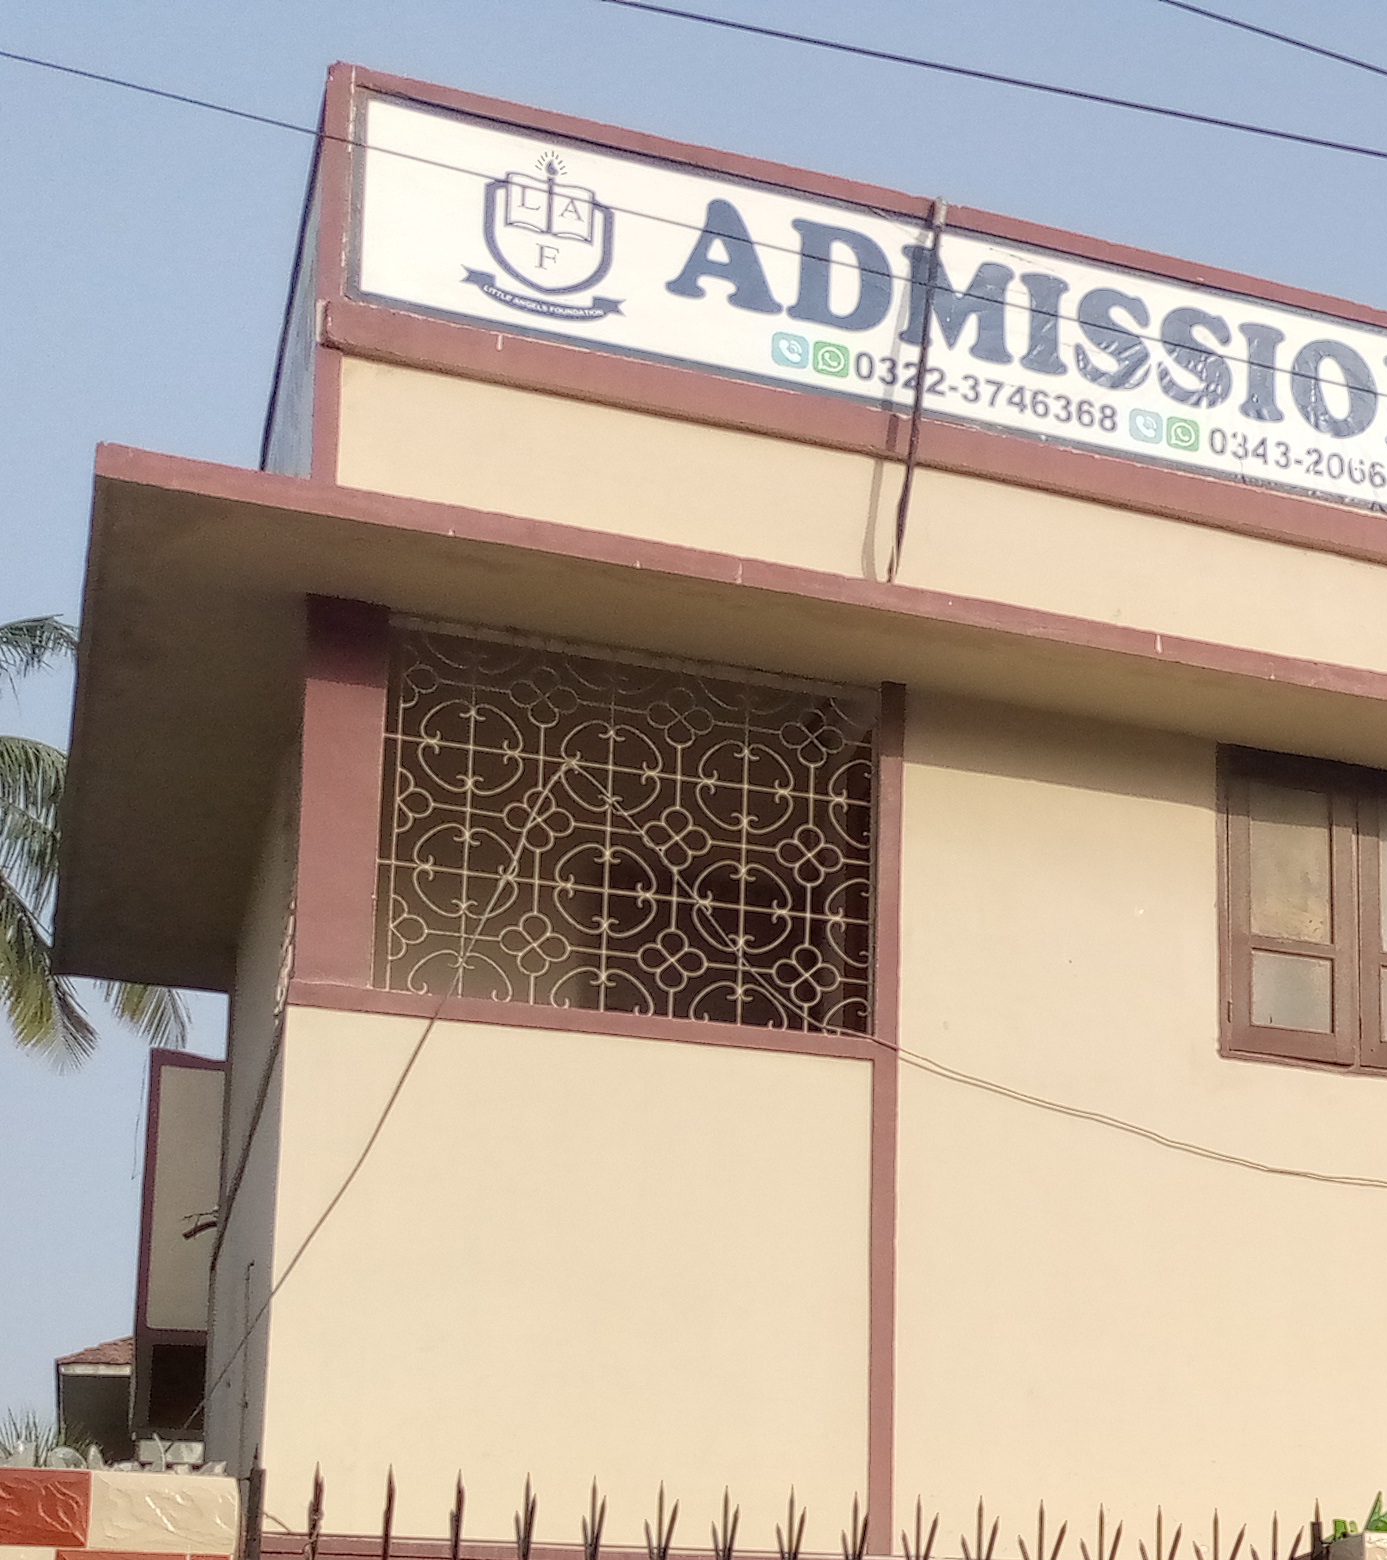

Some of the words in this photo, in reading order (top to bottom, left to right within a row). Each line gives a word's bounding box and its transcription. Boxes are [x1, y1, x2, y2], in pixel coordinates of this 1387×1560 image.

[517, 187, 541, 211] L
[558, 198, 584, 222] A
[534, 243, 560, 270] F
[483, 284, 512, 301] LITTLE
[512, 297, 548, 312] ANGELS
[549, 305, 604, 317] FOUNDATION
[854, 352, 1118, 432] 0322-3746368
